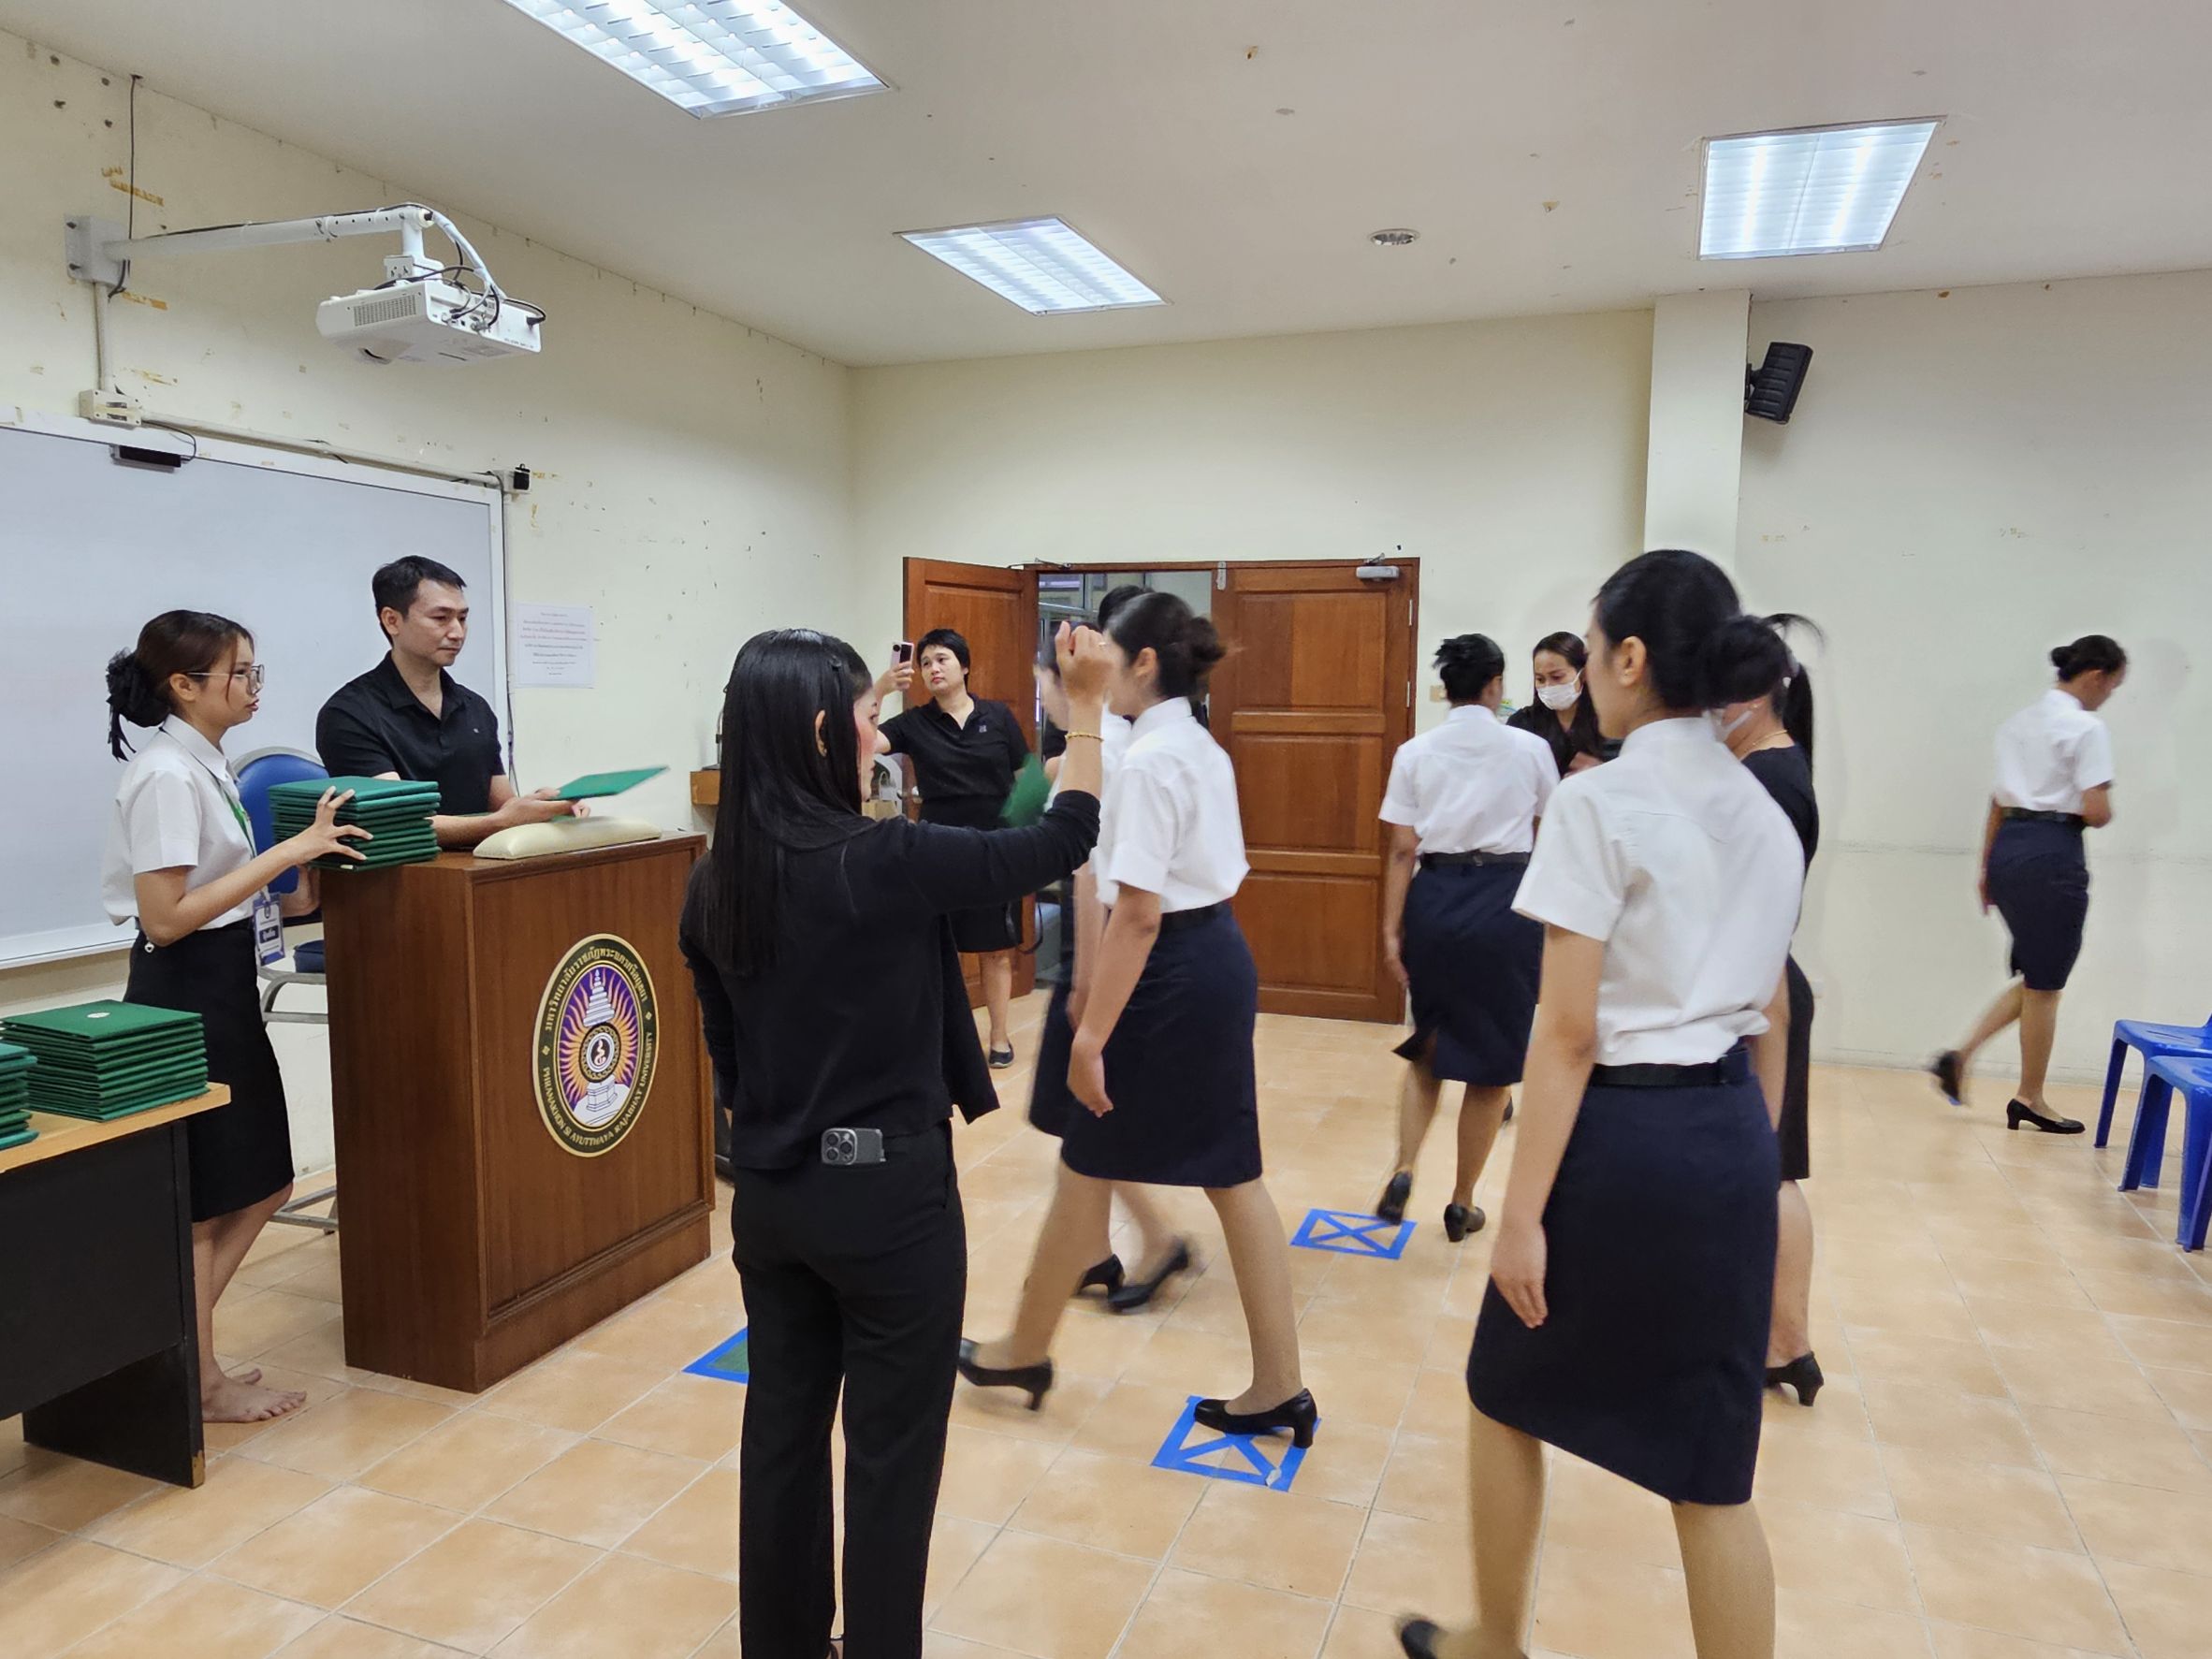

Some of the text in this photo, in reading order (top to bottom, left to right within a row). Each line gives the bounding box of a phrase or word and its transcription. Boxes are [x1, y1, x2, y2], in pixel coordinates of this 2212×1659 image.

[544, 1031, 653, 1146] PHRANAKHON SI AYUTTHAYA RAJABHAT UNIVERSITY
